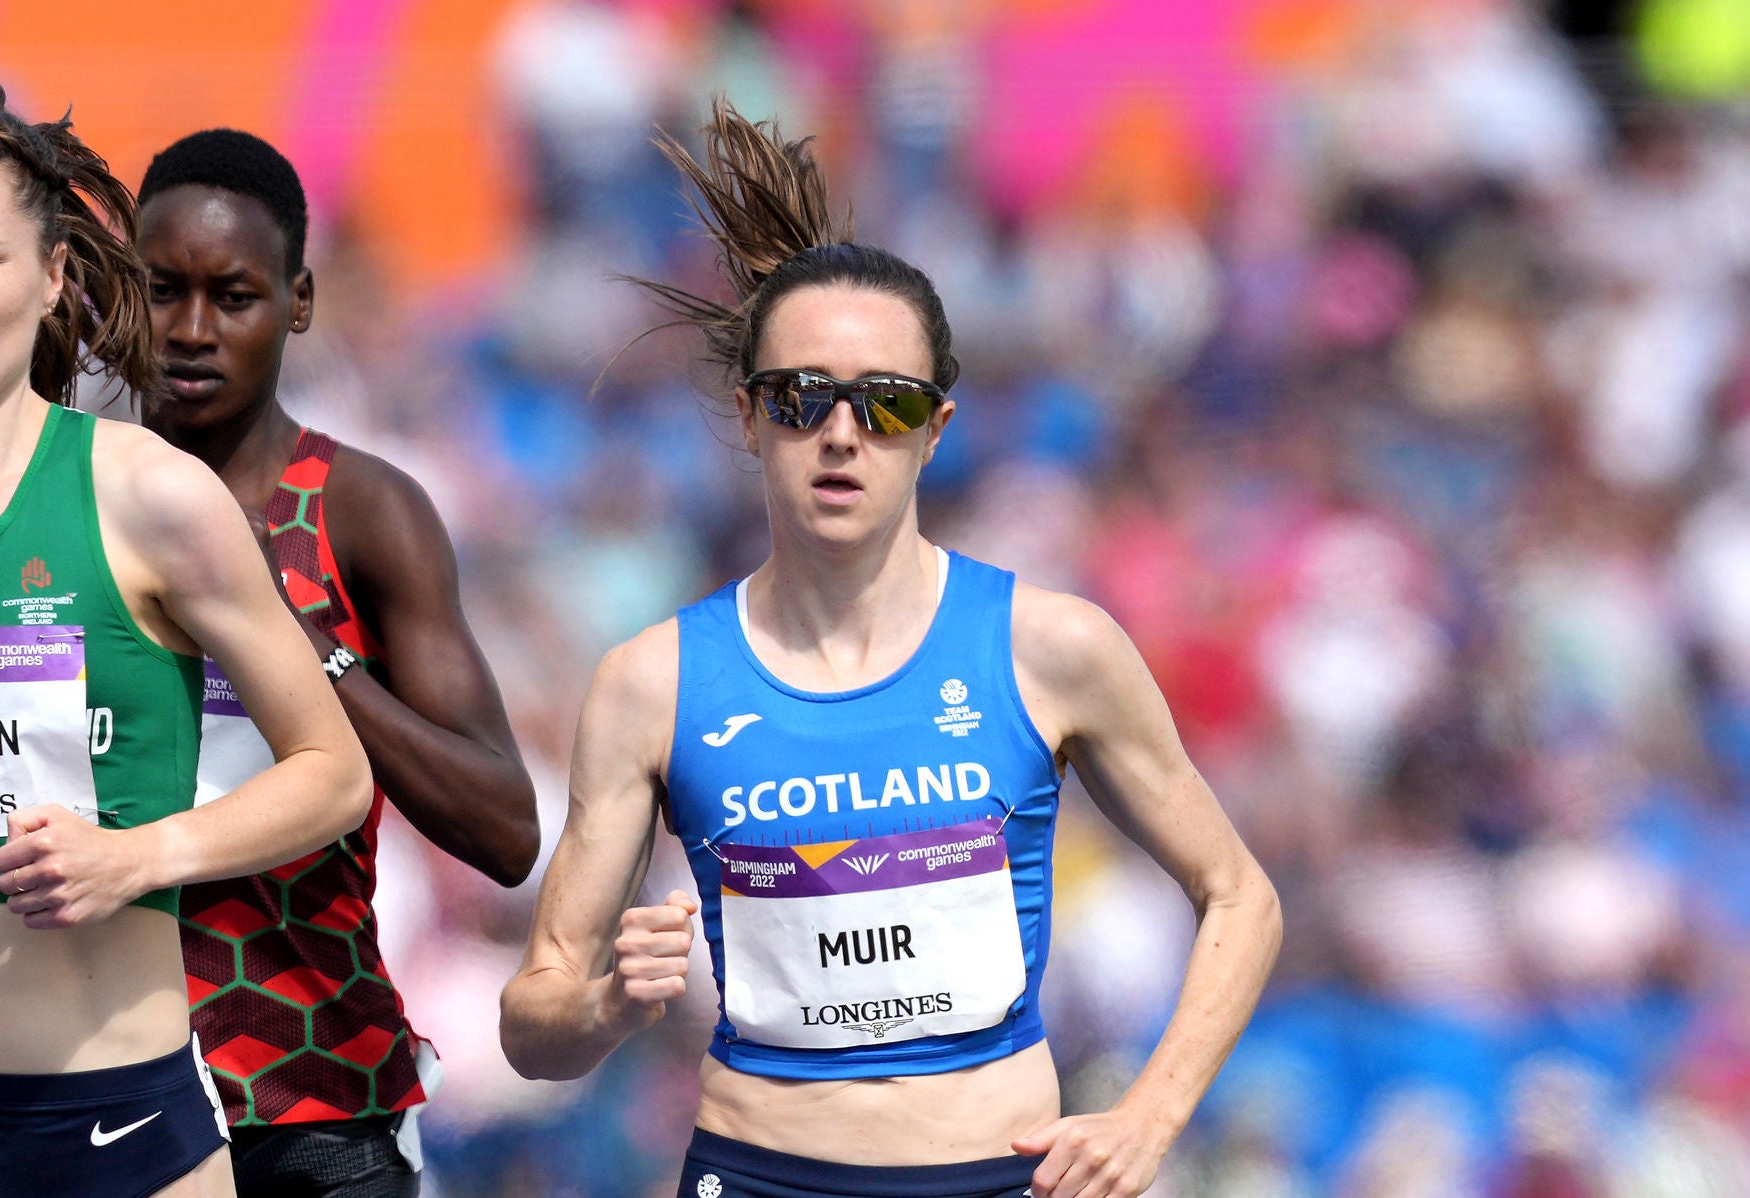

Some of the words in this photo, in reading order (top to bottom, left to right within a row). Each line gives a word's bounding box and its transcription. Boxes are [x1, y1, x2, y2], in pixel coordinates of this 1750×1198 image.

[2, 596, 74, 607] commonwealth
[20, 604, 54, 613] games
[933, 711, 982, 724] SCOTLAND
[722, 762, 991, 827] SCOTLAND
[898, 835, 996, 862] commonwealth
[730, 860, 796, 875] BIRMINGHAM
[926, 850, 972, 871] games
[750, 874, 776, 888] 2022
[818, 925, 916, 969] MUIR
[800, 992, 953, 1026] LONGINES
